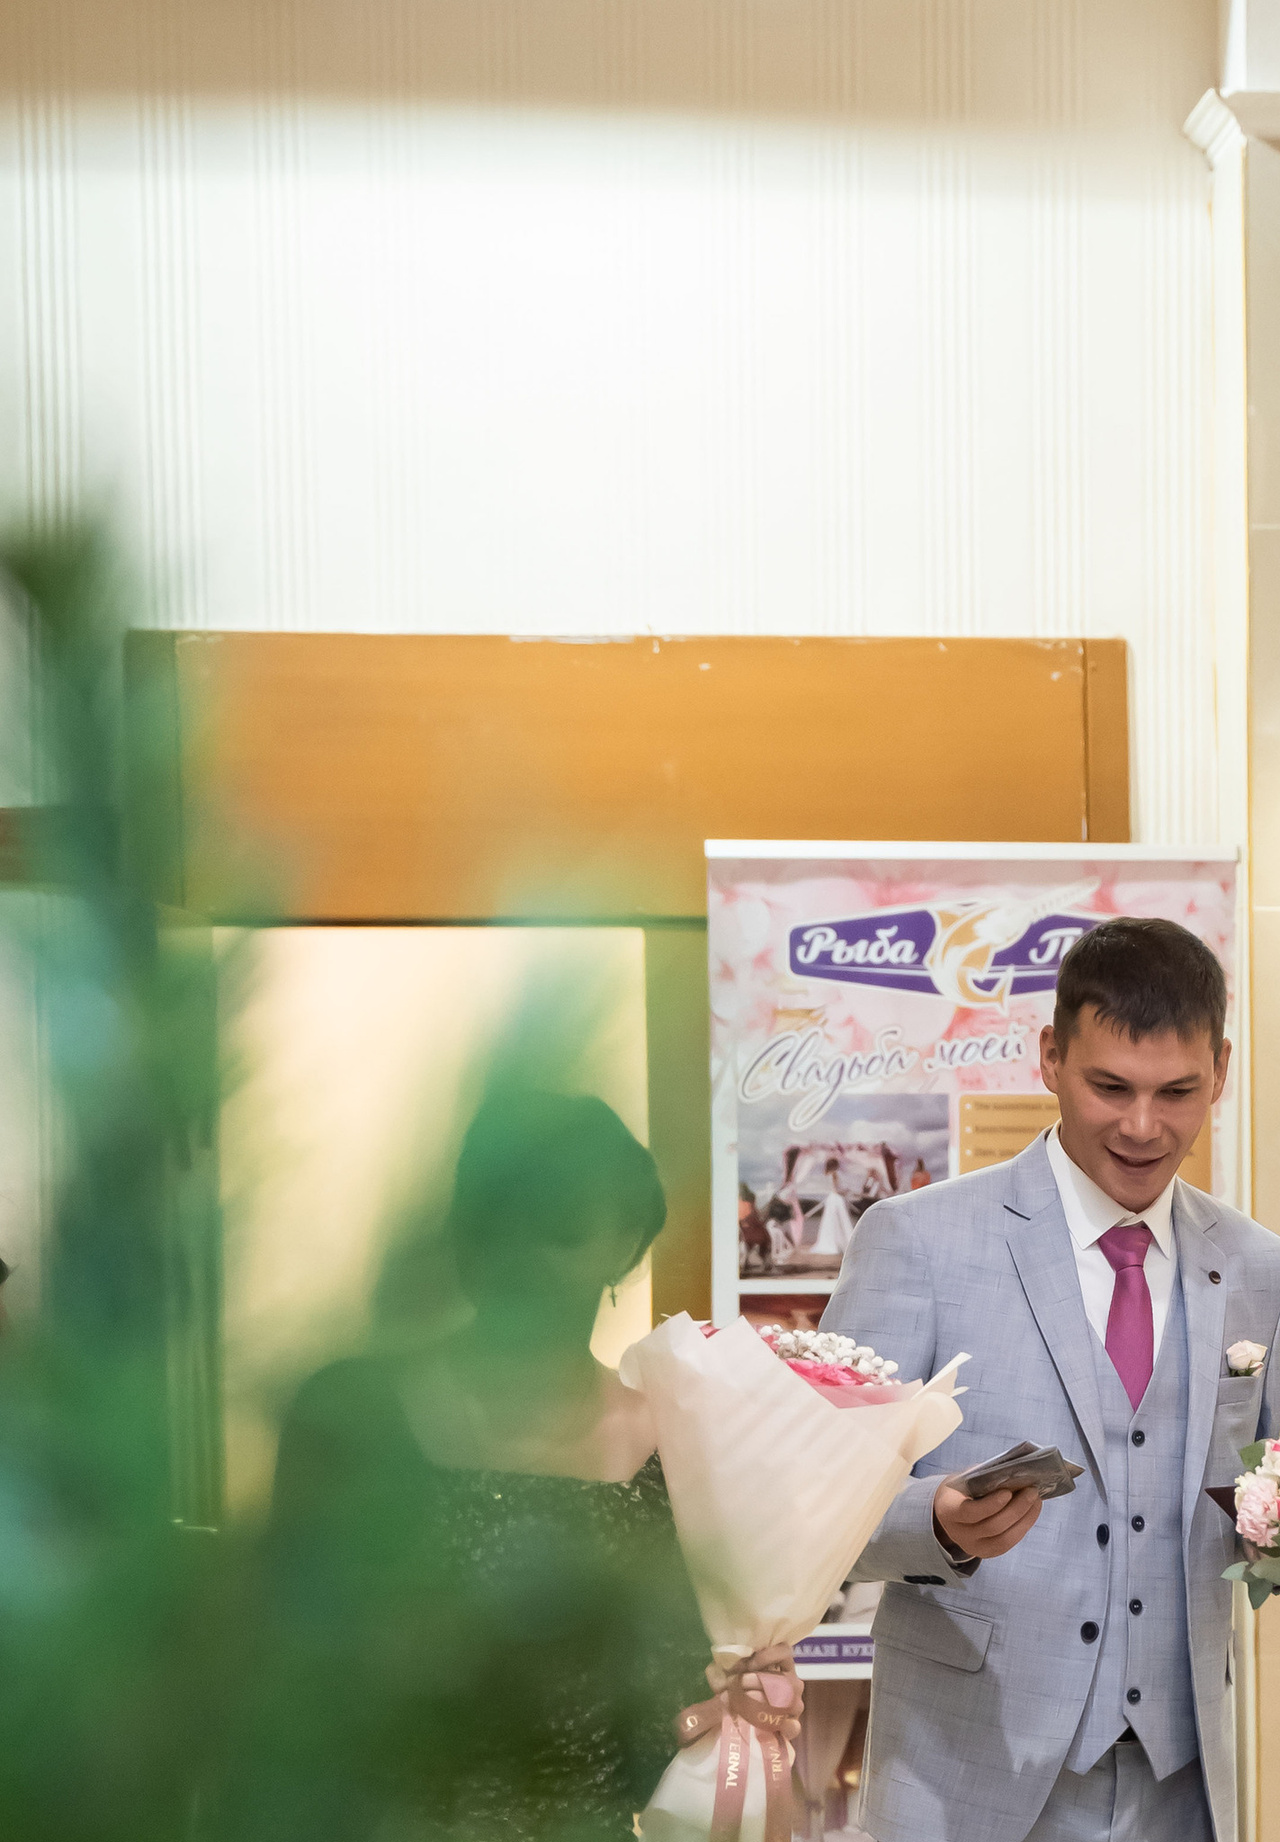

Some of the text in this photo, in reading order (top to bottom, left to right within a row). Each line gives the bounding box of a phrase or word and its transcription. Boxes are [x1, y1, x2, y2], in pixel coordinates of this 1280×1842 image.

[796, 926, 1082, 965] Рыба П
[740, 1024, 1026, 1130] Свадьба моей
